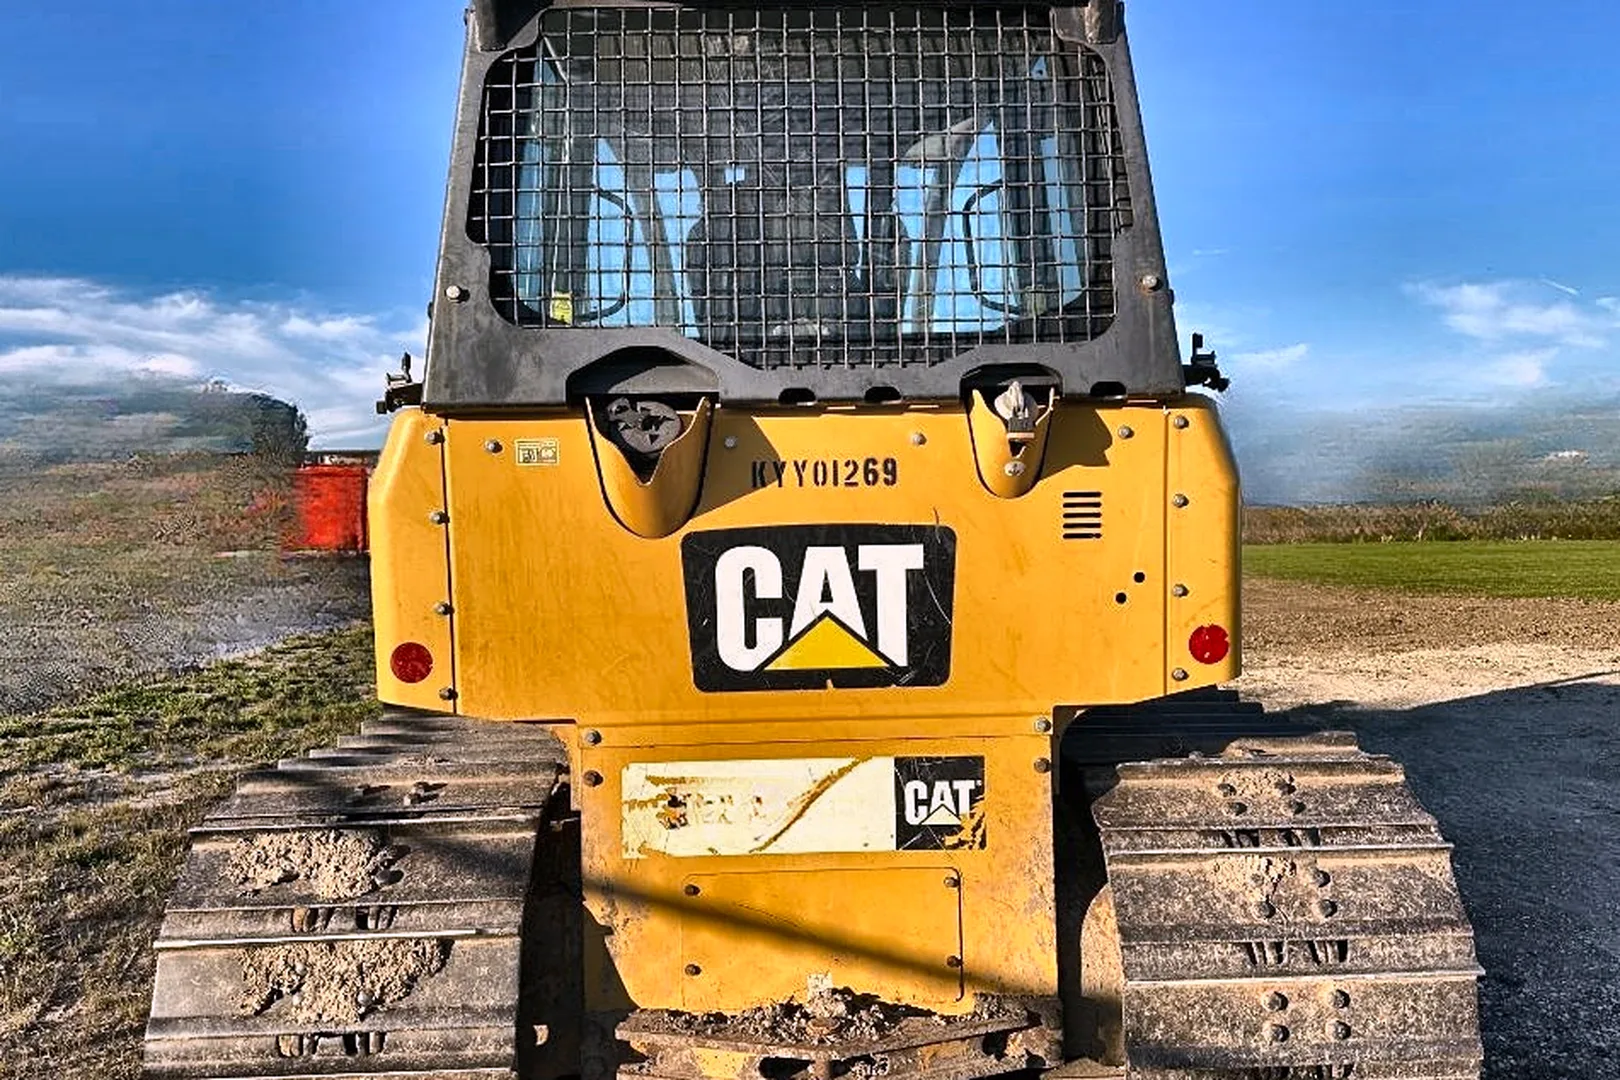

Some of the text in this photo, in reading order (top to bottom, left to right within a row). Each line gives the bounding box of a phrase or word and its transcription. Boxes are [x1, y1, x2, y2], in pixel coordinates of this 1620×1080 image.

[751, 457, 897, 488] KYY01269
[715, 544, 924, 672] CAT
[904, 780, 976, 825] CAT
